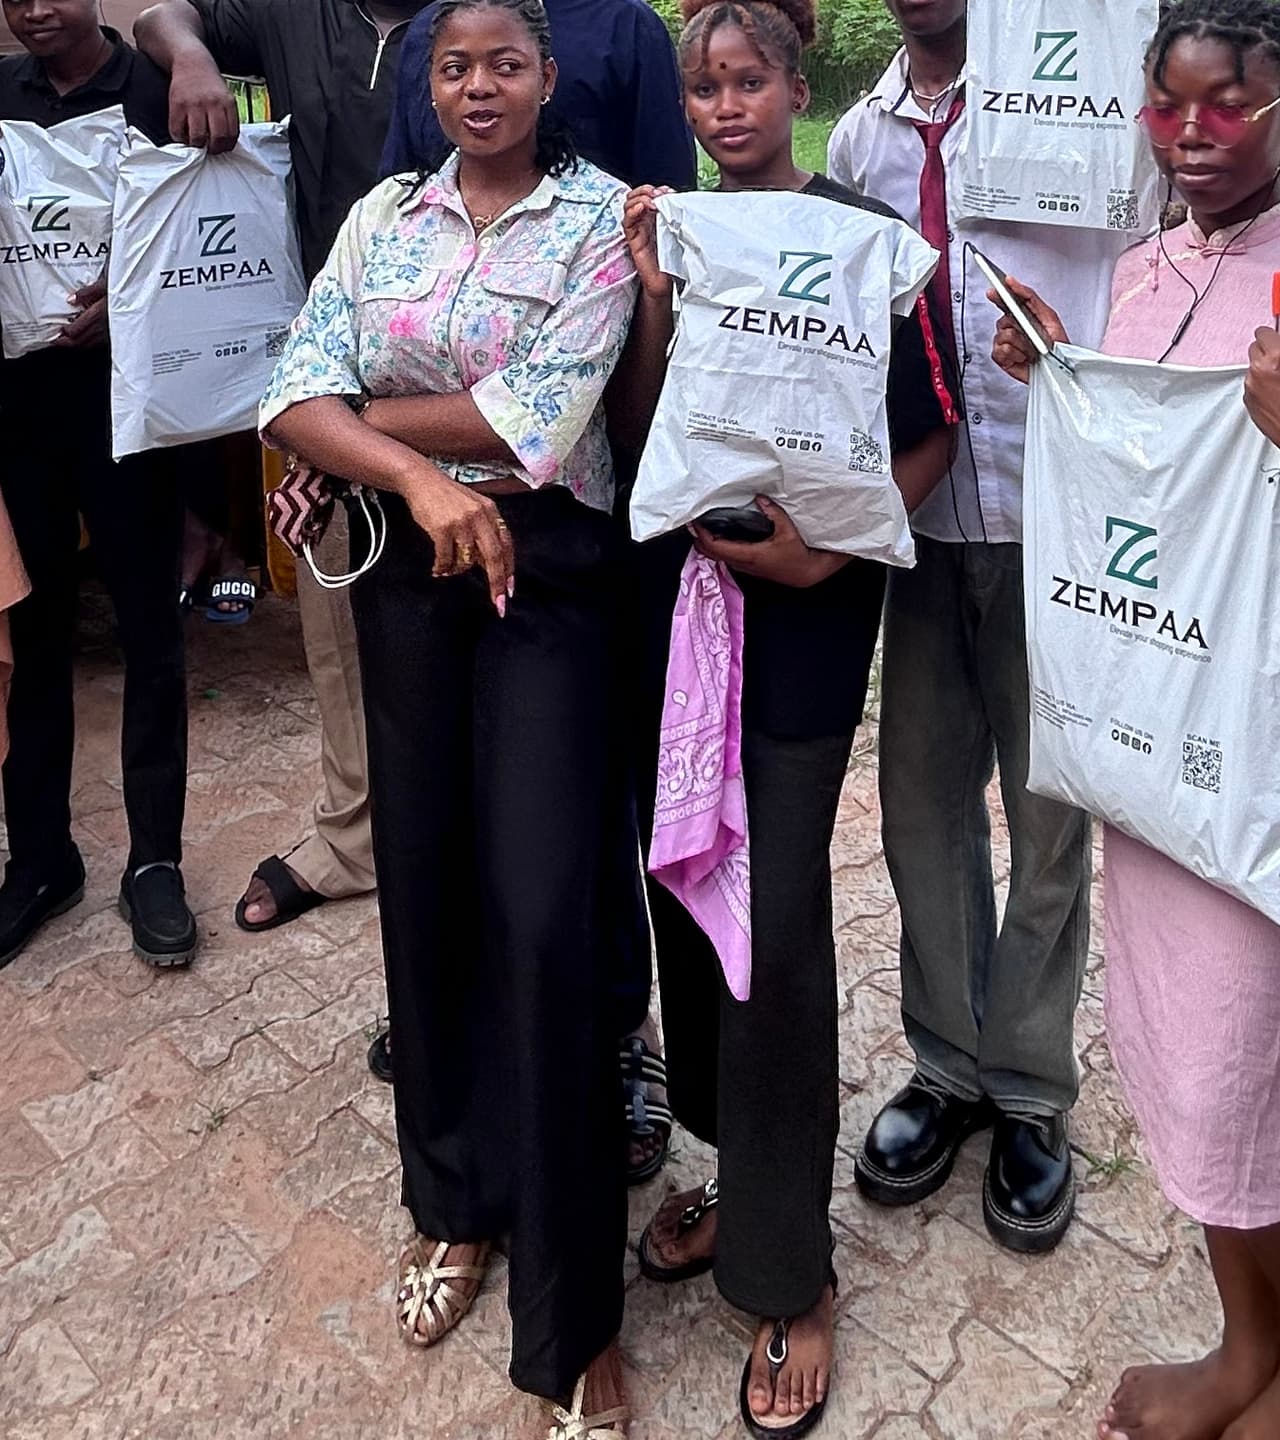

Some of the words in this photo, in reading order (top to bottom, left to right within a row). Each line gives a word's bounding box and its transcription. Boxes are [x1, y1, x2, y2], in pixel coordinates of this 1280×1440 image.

[981, 89, 1126, 119] ZEMPAA
[0, 242, 109, 264] ZEMPAA
[160, 258, 273, 289] ZEMPAA
[718, 305, 877, 358] ZEMPAA
[212, 581, 256, 598] GUCCI
[1050, 574, 1210, 650] ZEMPAA
